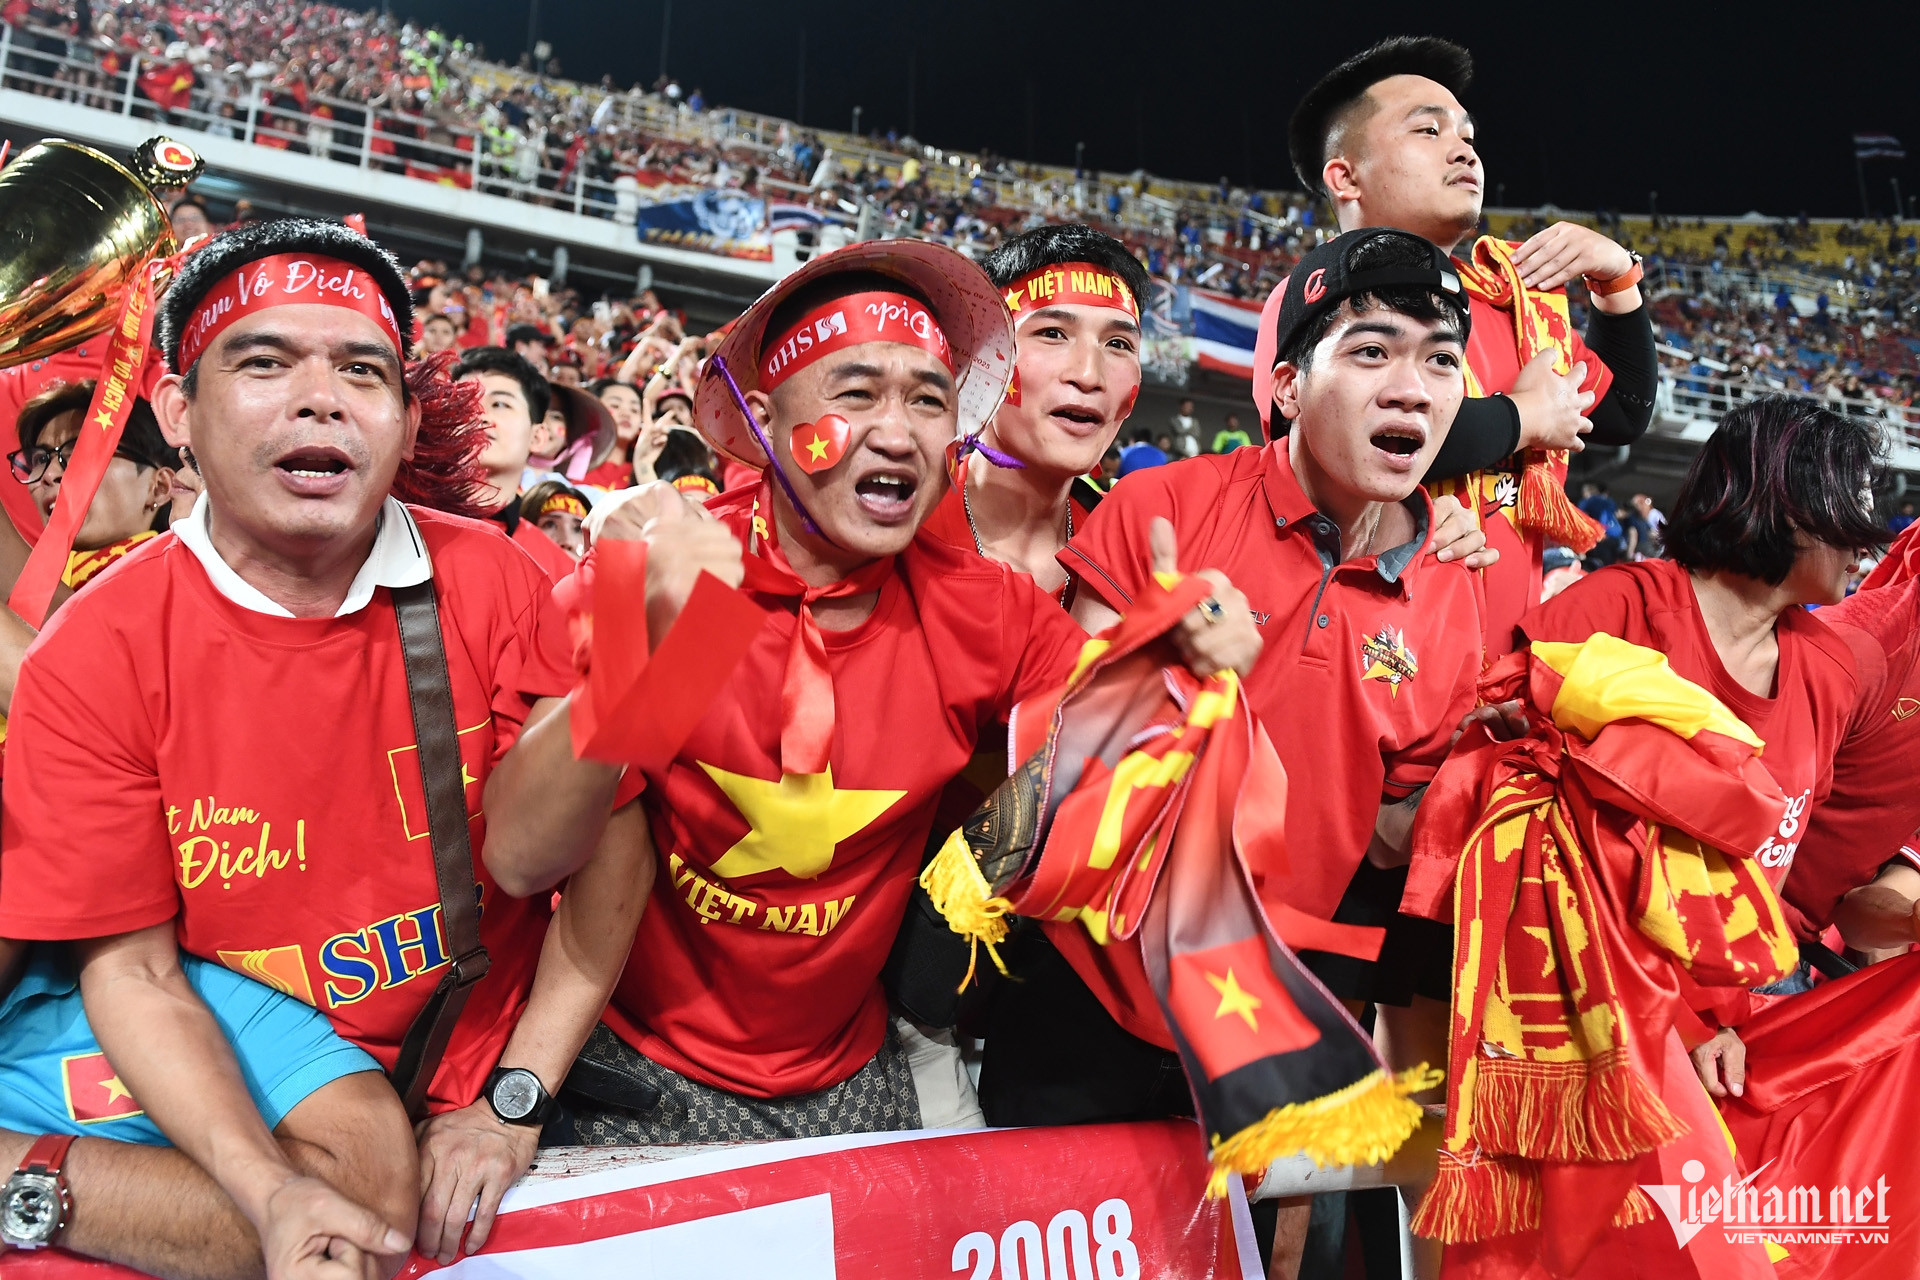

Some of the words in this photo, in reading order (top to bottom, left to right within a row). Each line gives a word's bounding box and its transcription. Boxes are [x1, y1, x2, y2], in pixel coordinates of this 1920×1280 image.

[238, 263, 274, 306] Vô
[282, 260, 366, 300] Địch
[1028, 270, 1065, 301] VIỆT
[1071, 271, 1113, 299] NAM
[113, 358, 133, 380] VÔ
[102, 375, 127, 413] ĐỊCH
[188, 796, 260, 832] Nam
[669, 852, 757, 925] VIỆT
[758, 895, 856, 937] NAM
[319, 881, 484, 1009] SH
[952, 1198, 1140, 1280] 2008
